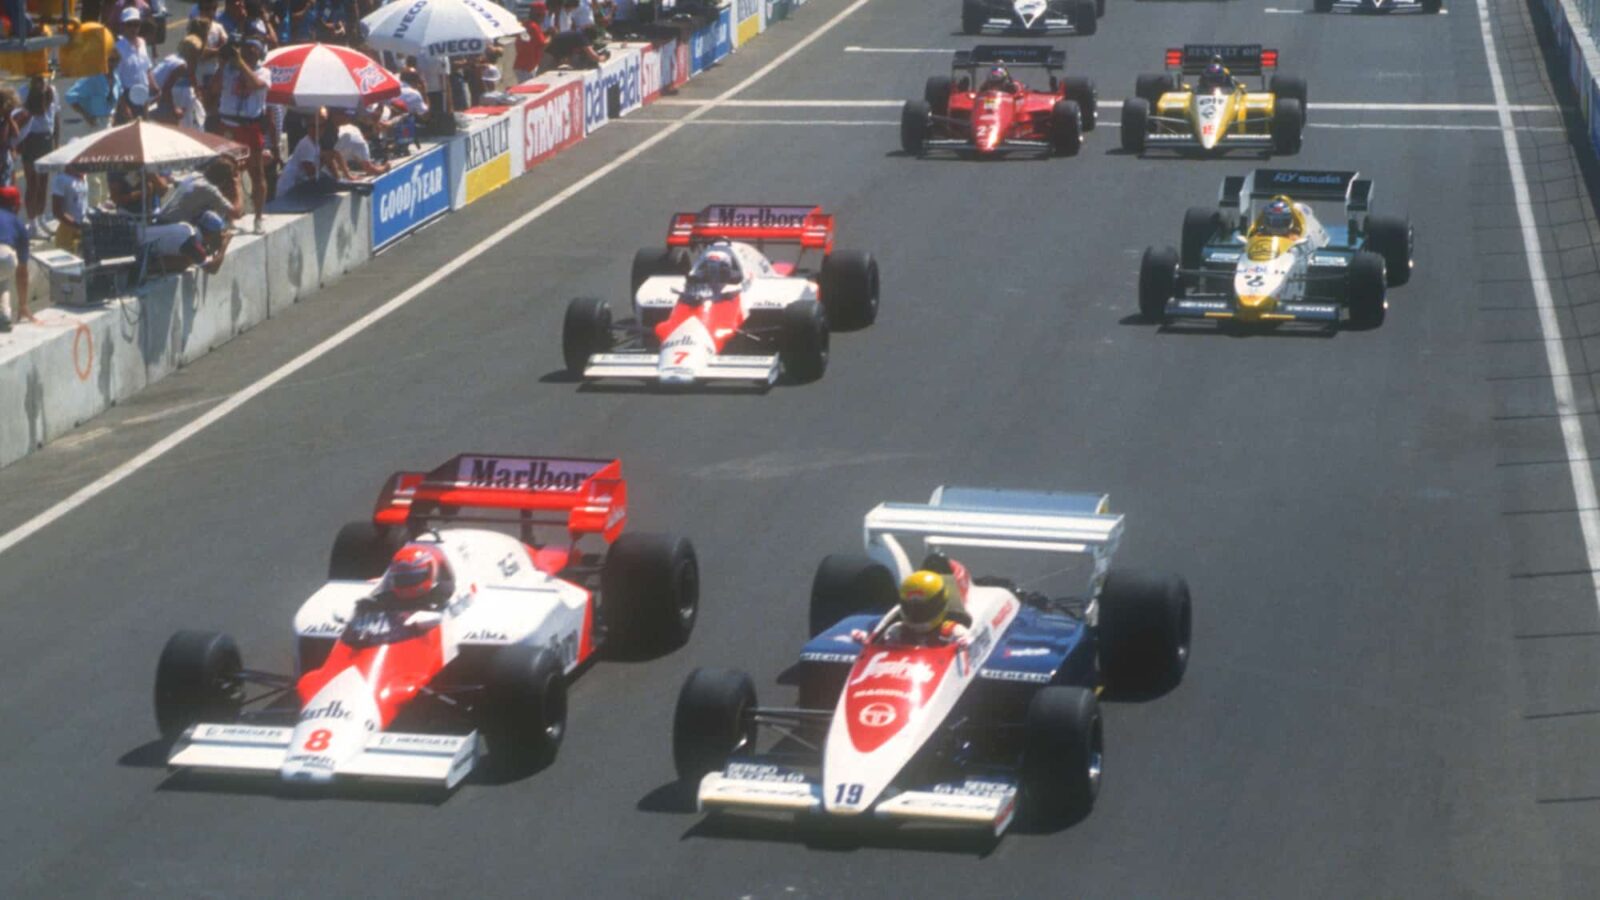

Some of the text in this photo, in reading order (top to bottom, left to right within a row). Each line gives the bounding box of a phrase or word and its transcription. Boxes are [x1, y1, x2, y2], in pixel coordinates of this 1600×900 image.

[428, 37, 483, 56] IVECO
[464, 117, 510, 172] RENAULT
[380, 163, 443, 224] GOODYEAR
[674, 351, 690, 365] 7
[472, 458, 587, 490] Marlbor
[304, 728, 333, 752] 8
[834, 783, 864, 805] 19
